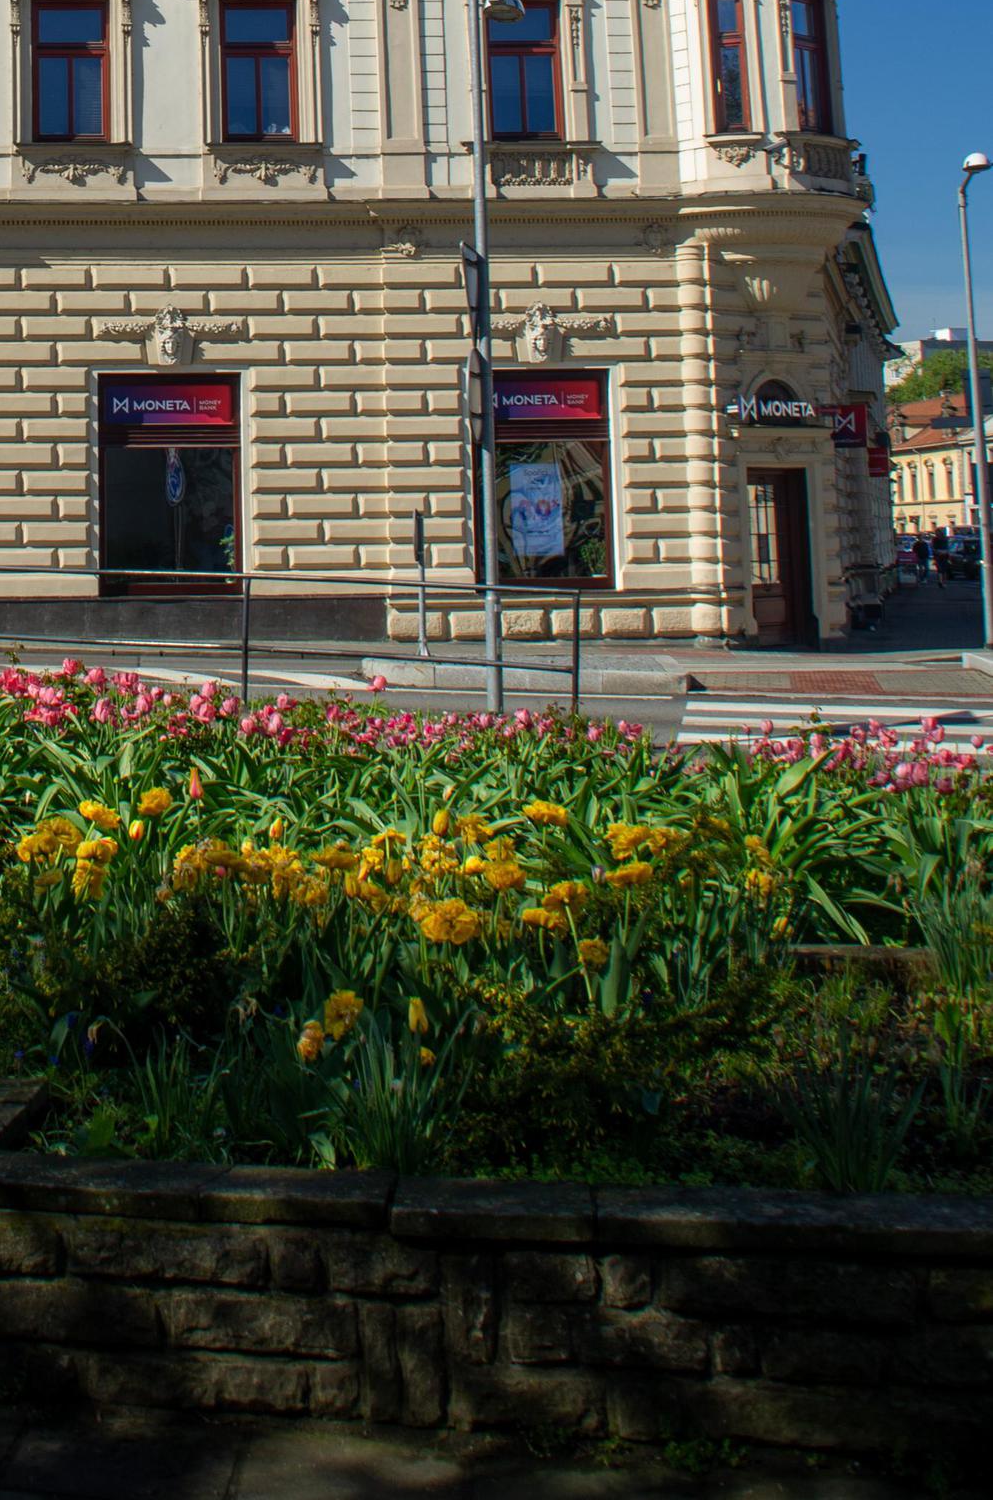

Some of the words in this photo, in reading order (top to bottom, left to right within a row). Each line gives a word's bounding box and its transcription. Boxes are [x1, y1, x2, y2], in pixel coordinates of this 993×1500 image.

[133, 400, 191, 411] MONETA
[501, 394, 559, 406] MONETA
[760, 400, 816, 417] MONETA
